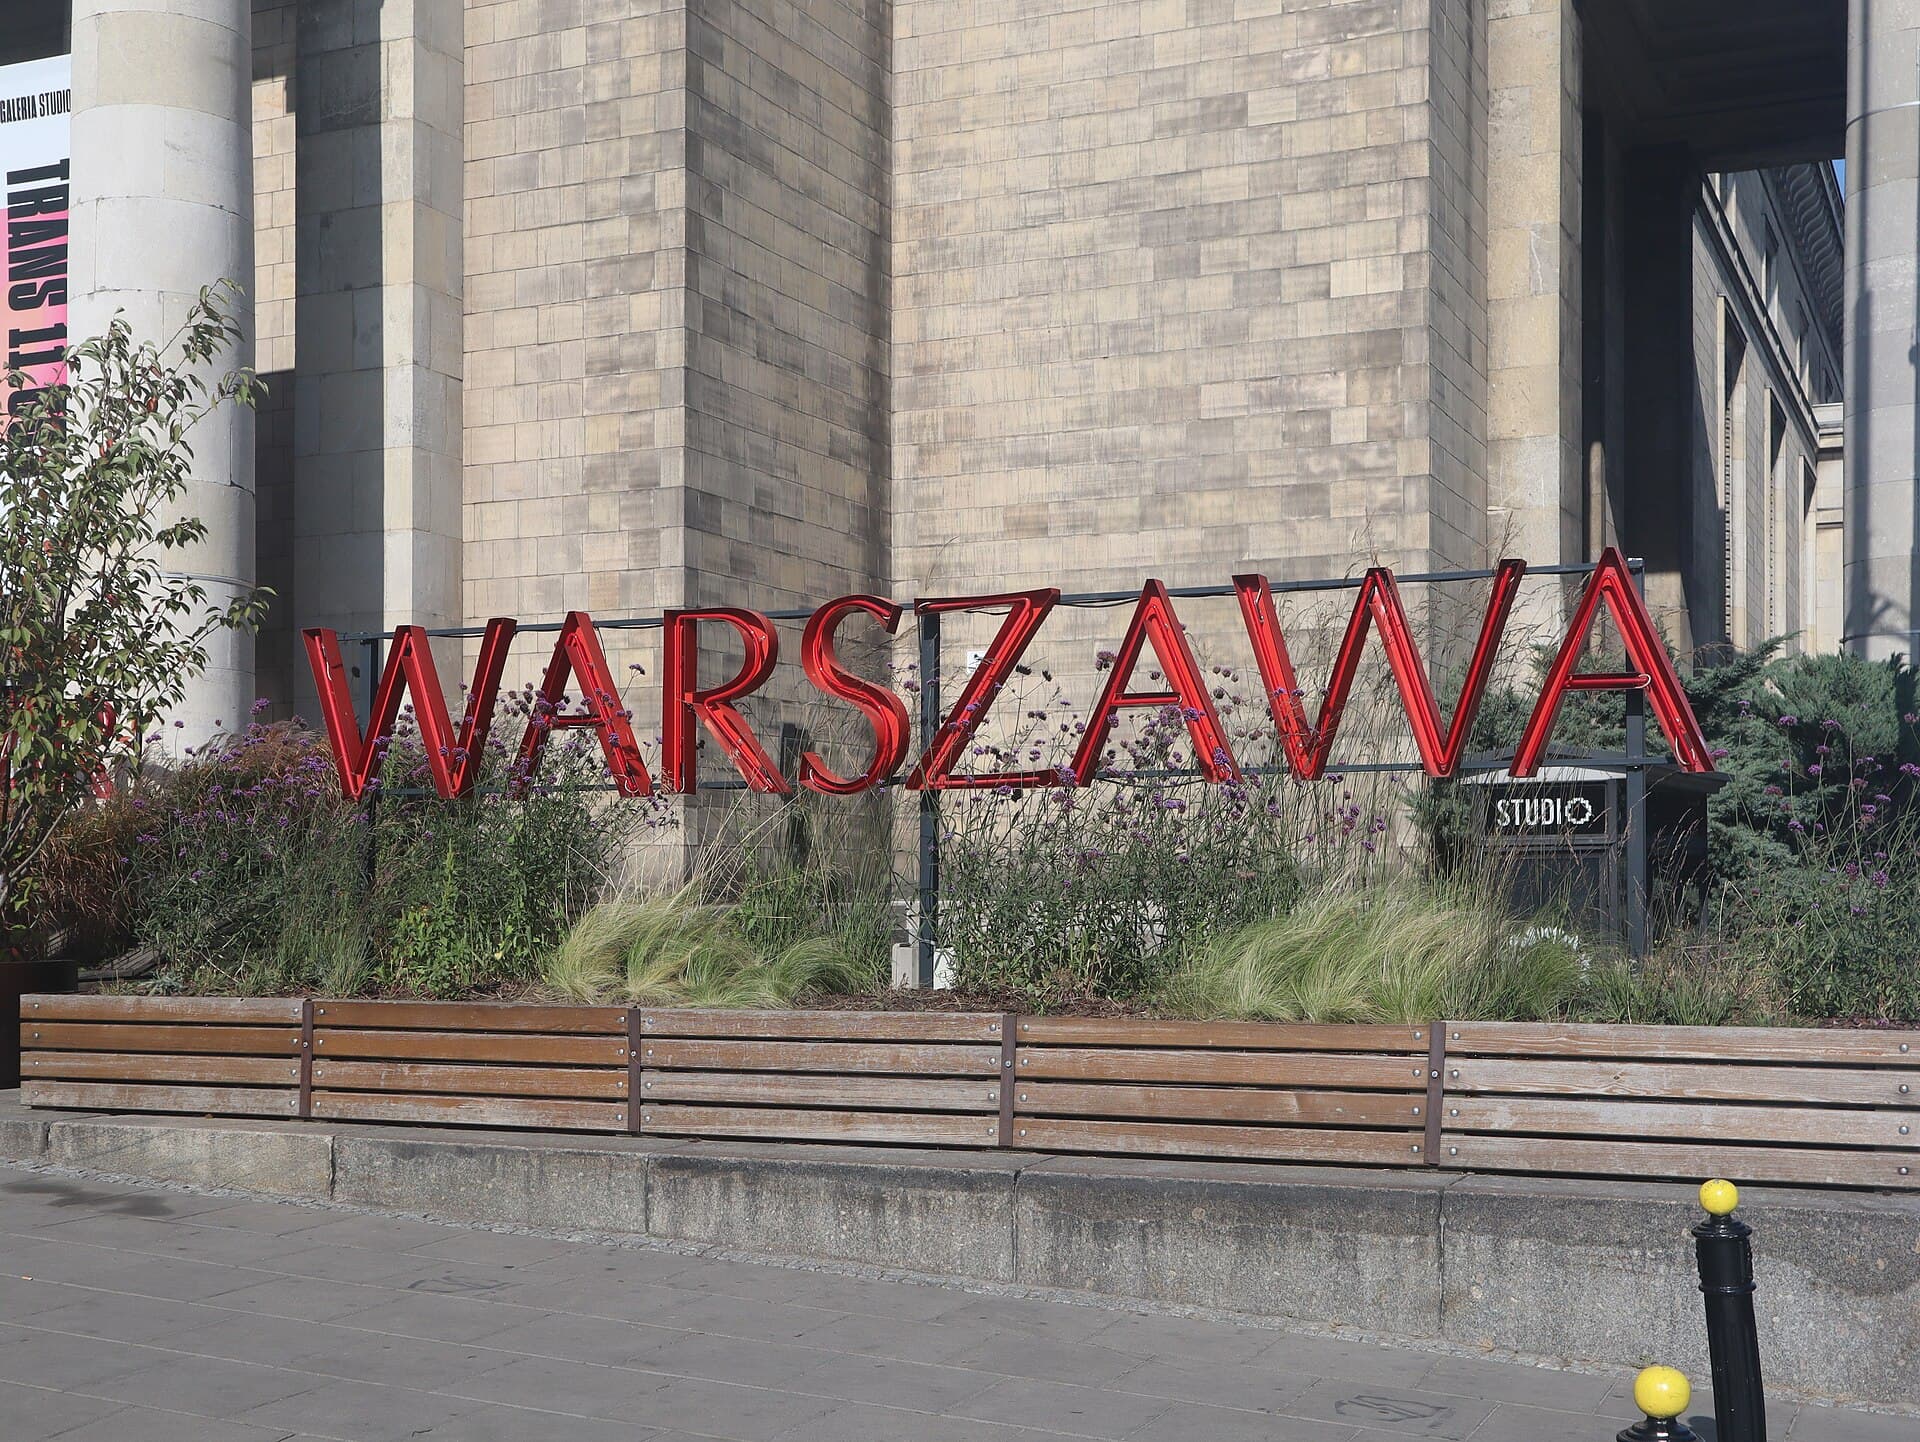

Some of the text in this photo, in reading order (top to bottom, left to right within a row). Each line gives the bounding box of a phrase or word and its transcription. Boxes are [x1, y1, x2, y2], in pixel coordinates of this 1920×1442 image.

[0, 88, 71, 124] GALERIA STUDIO
[7, 158, 70, 312] TRANS
[302, 546, 1716, 799] WARSZAWA
[1497, 797, 1592, 827] STUDIO
